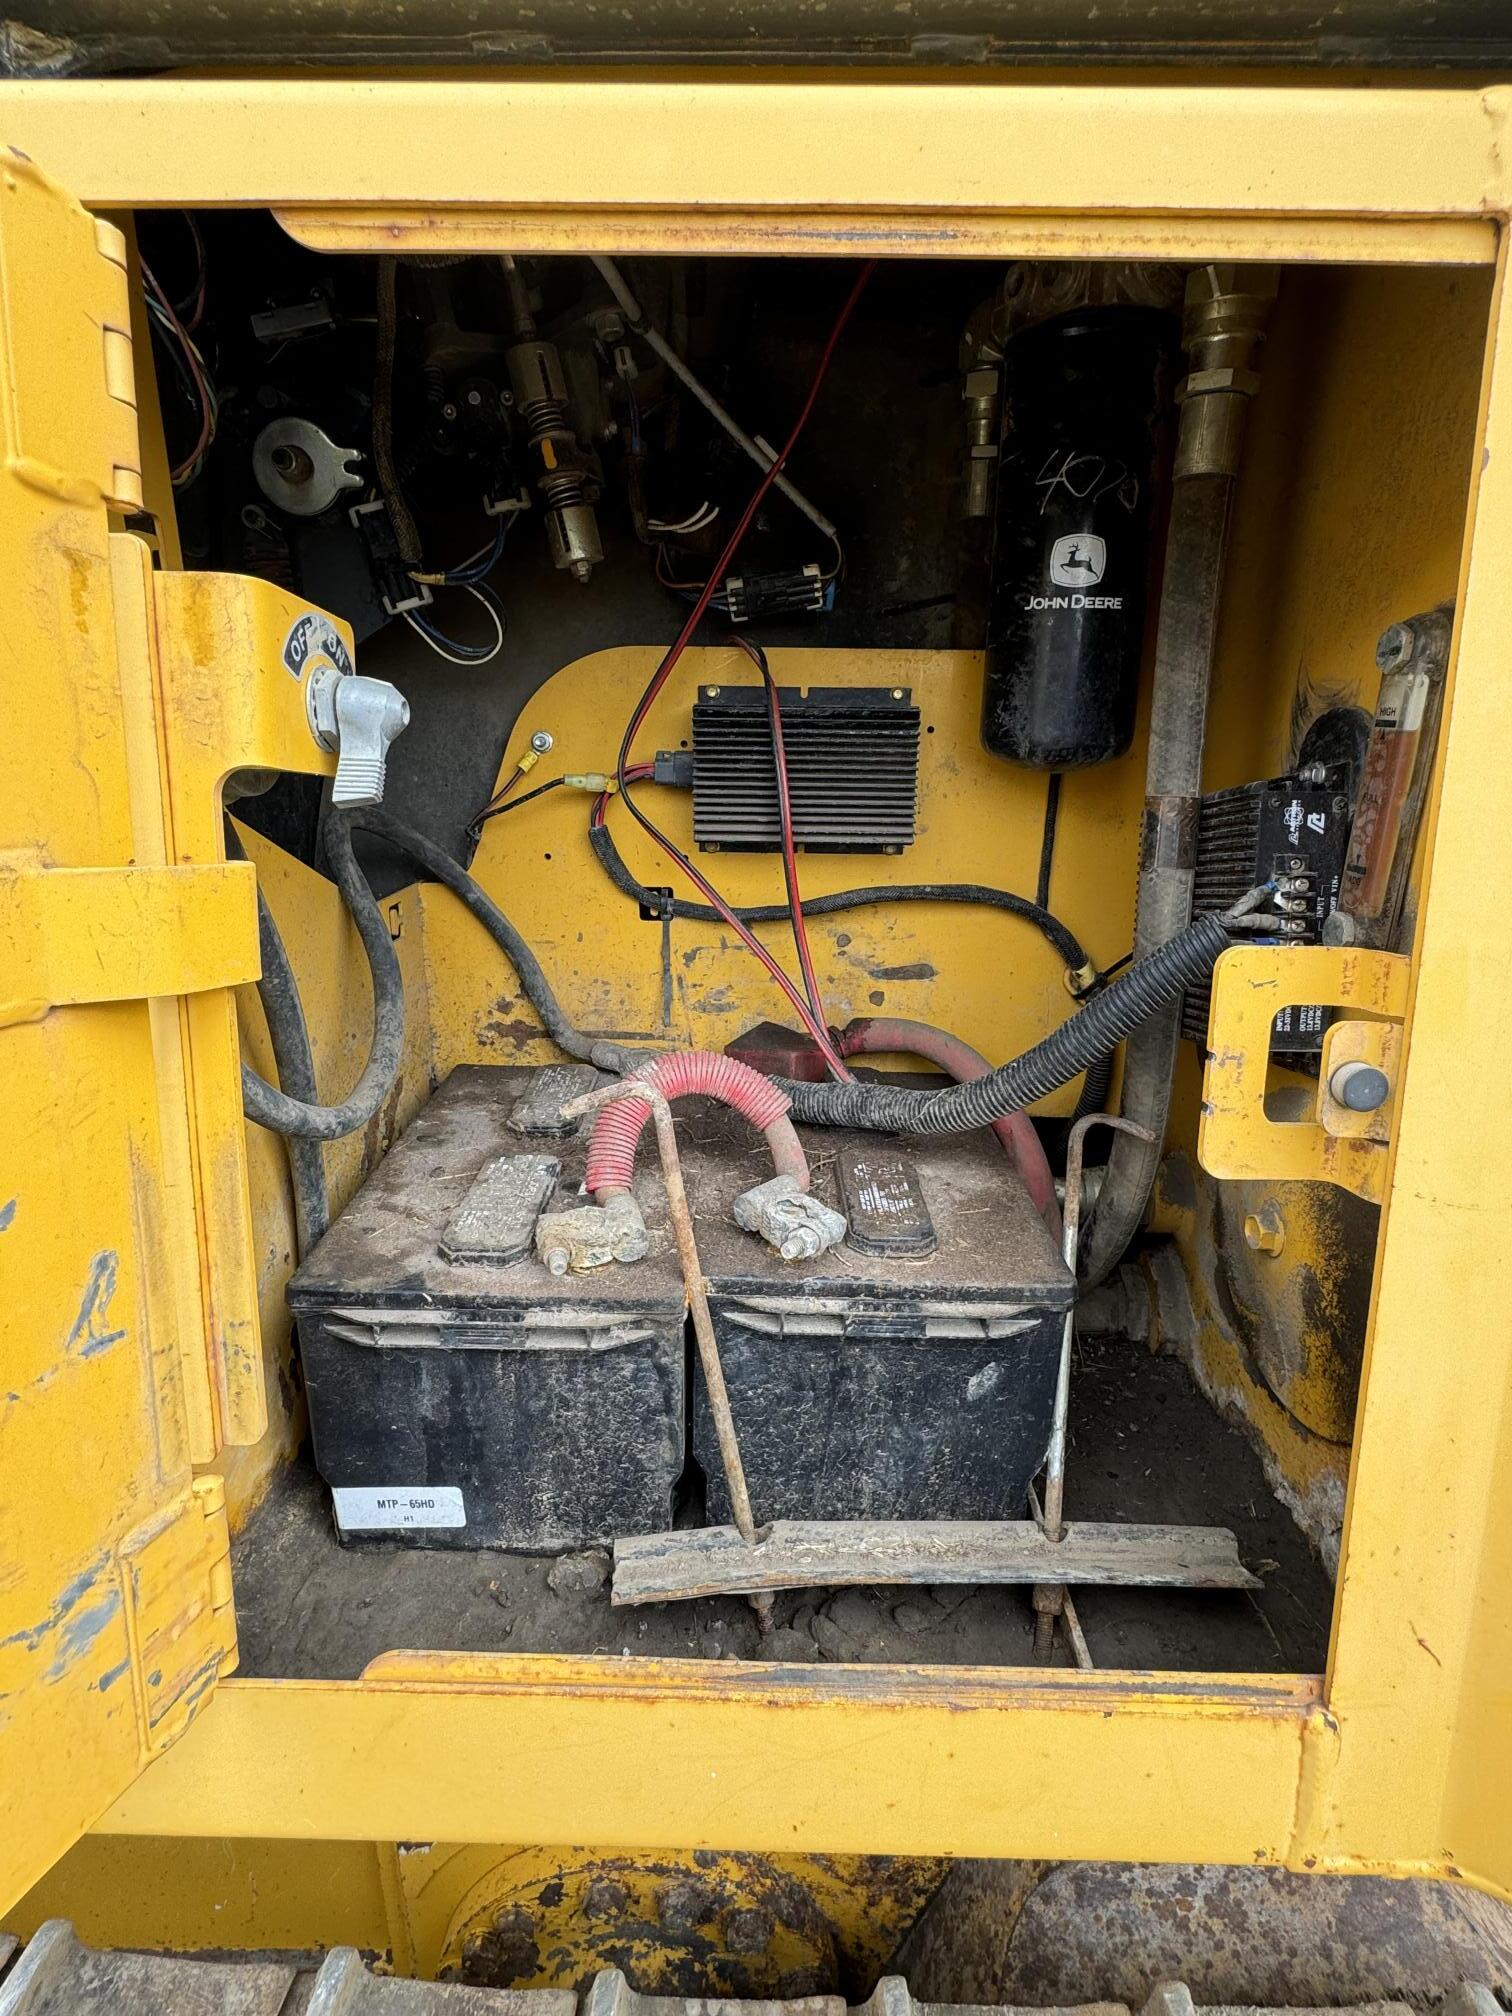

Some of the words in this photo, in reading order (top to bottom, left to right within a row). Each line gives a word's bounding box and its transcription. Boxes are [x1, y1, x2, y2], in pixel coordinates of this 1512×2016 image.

[1024, 595, 1069, 611] JOHN
[1071, 594, 1123, 610] DEERE
[327, 633, 345, 668] ON
[1379, 706, 1397, 718] HIGH
[1330, 875, 1339, 893] VIN+
[1316, 896, 1326, 918] INPUT
